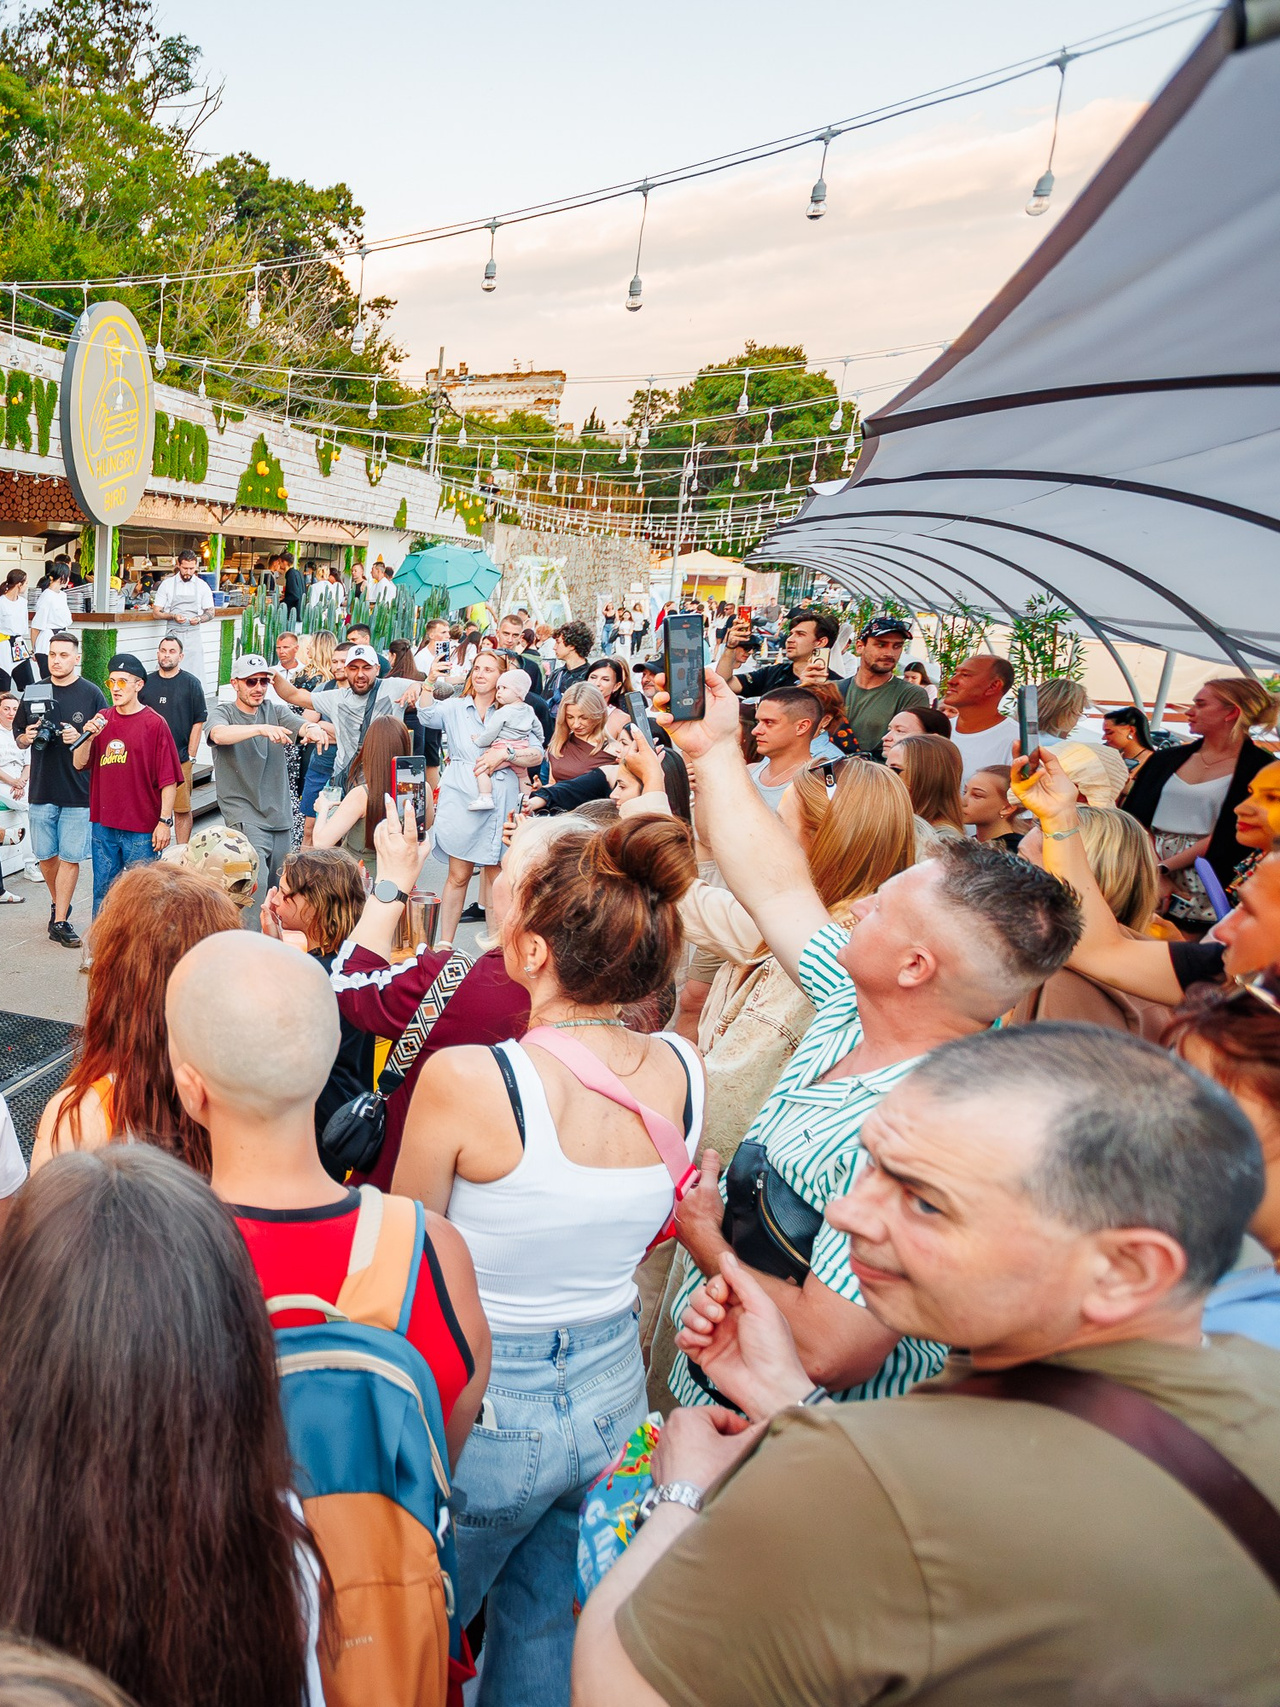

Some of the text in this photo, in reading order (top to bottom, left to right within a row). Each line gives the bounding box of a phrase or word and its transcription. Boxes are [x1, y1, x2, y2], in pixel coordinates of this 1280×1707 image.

[153, 410, 210, 485] BIRD
[95, 449, 136, 480] HUNGRY
[103, 488, 128, 512] BIRD
[99, 750, 128, 767] Codered
